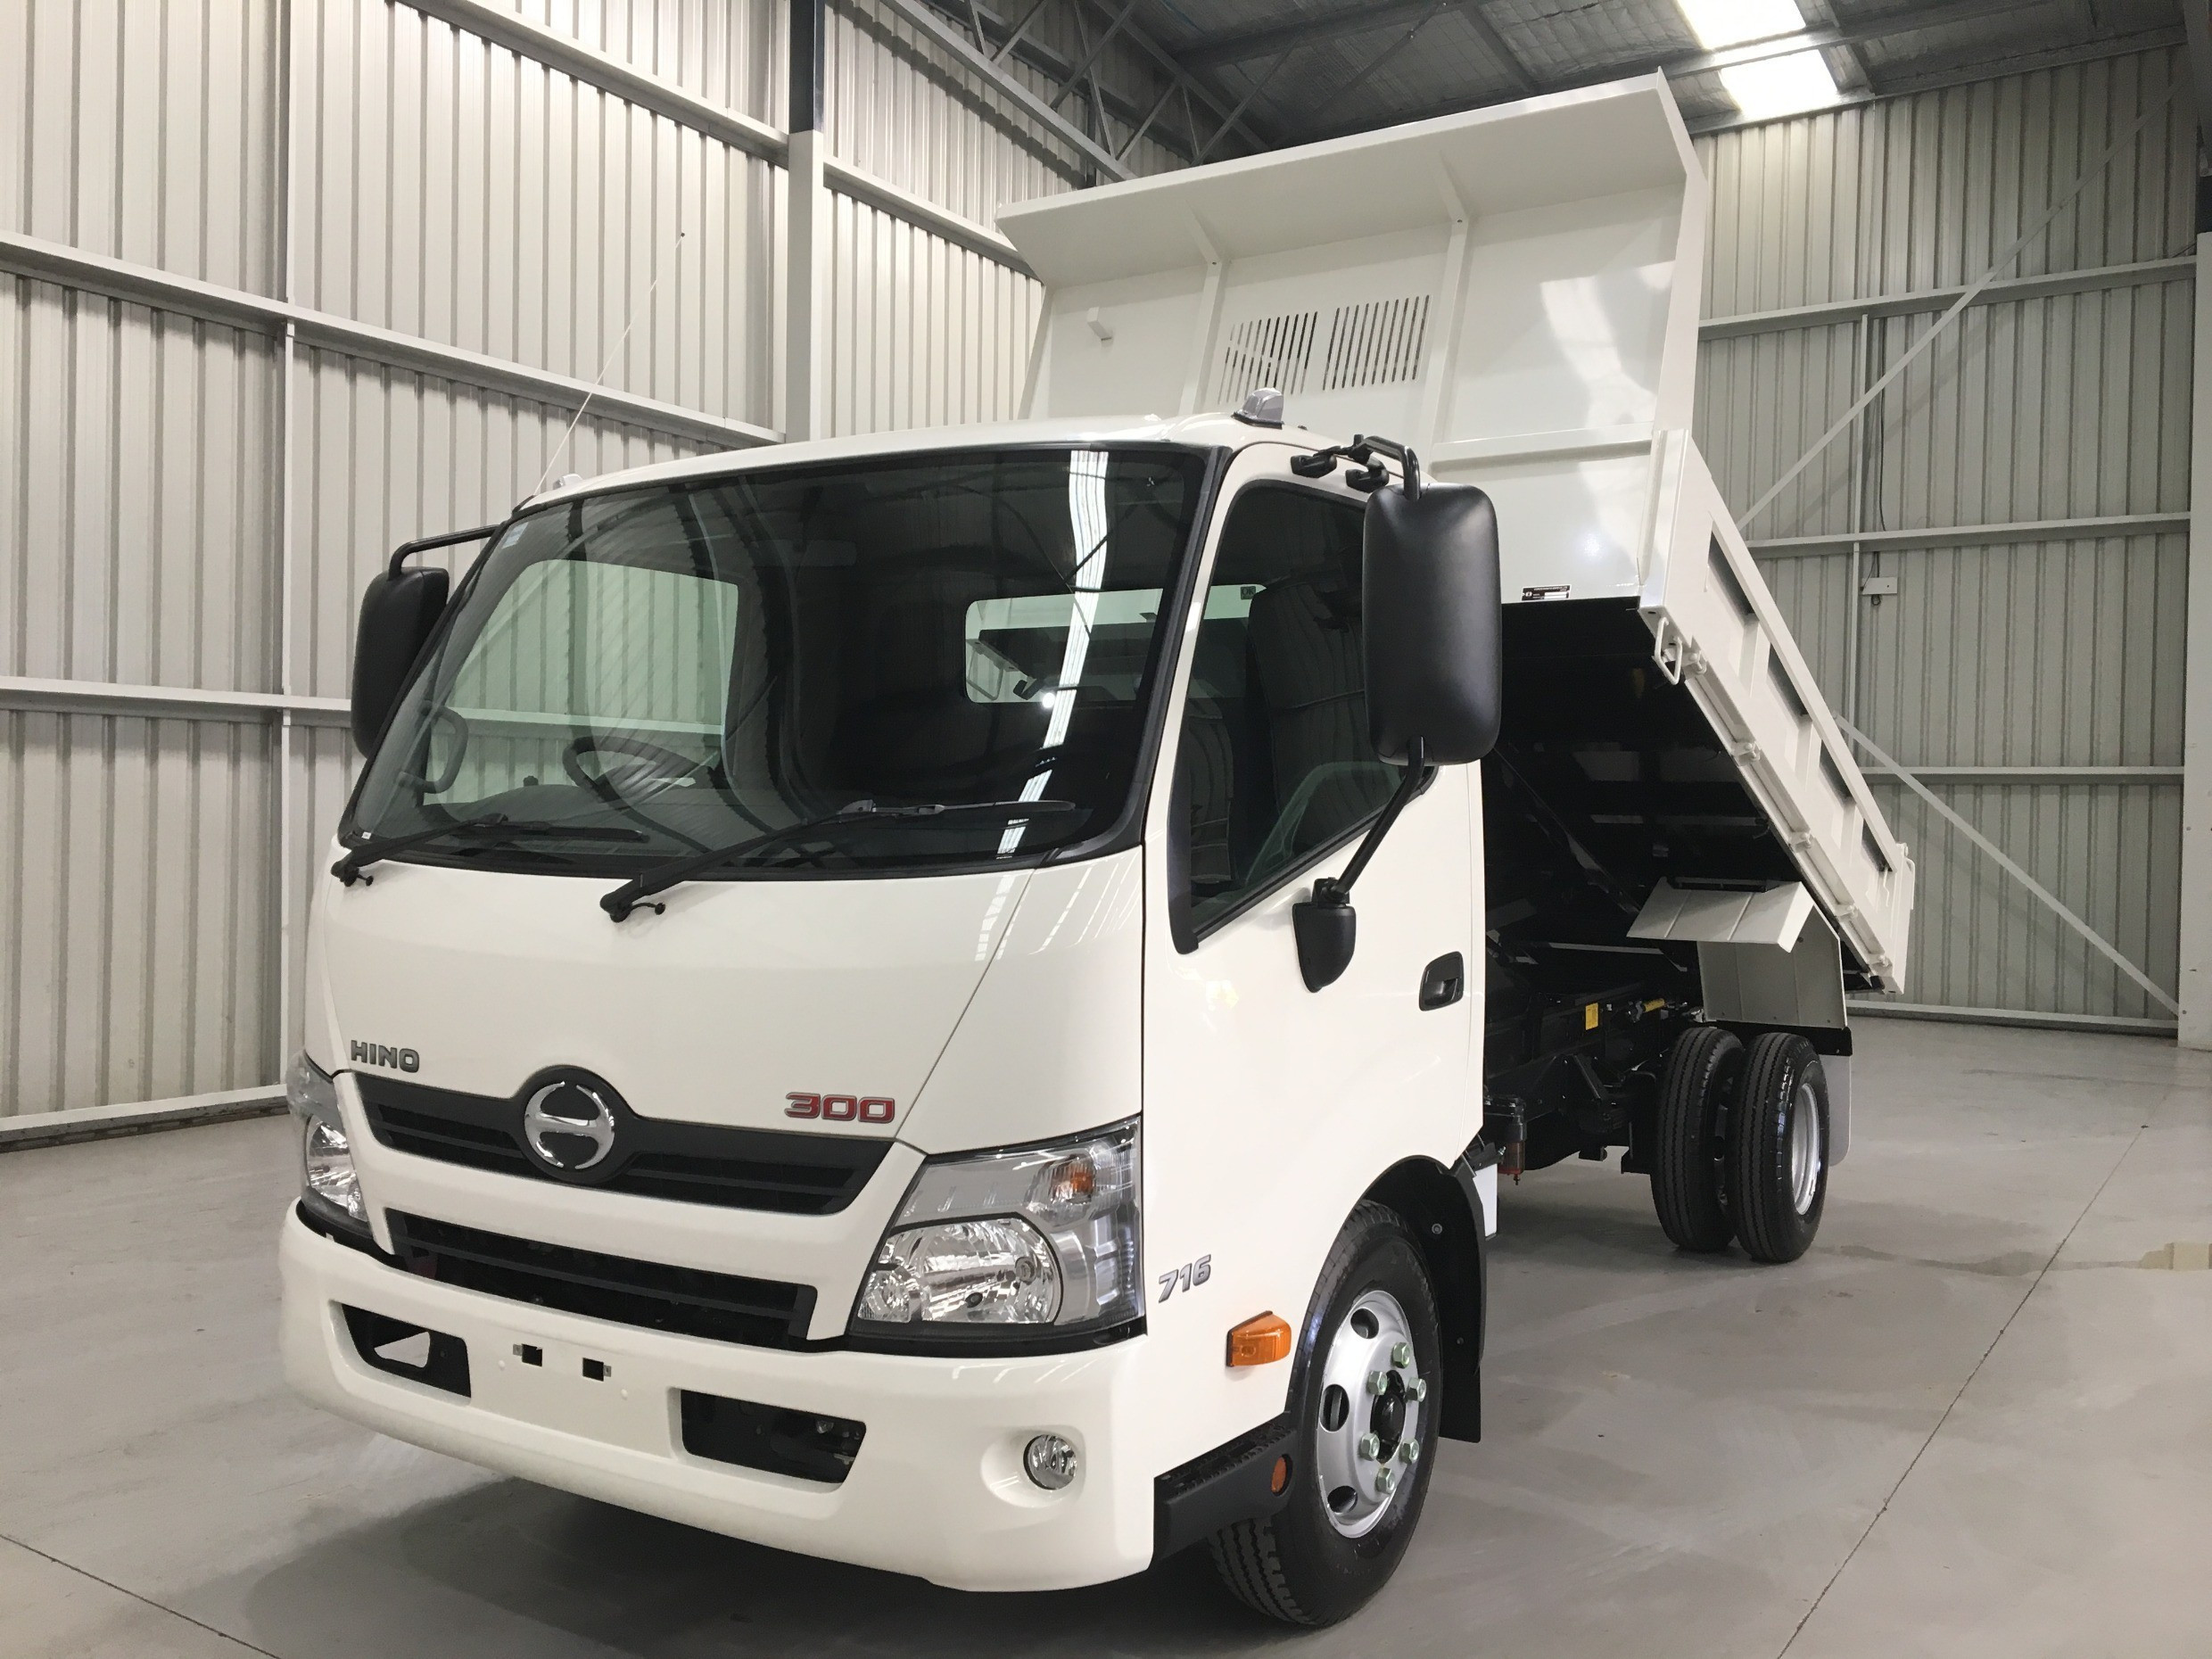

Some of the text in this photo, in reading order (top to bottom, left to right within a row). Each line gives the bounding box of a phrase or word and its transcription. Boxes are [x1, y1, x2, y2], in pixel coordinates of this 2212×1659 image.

[351, 1039, 420, 1073] HINO
[784, 1092, 896, 1124] 300
[1159, 1254, 1211, 1303] 716
